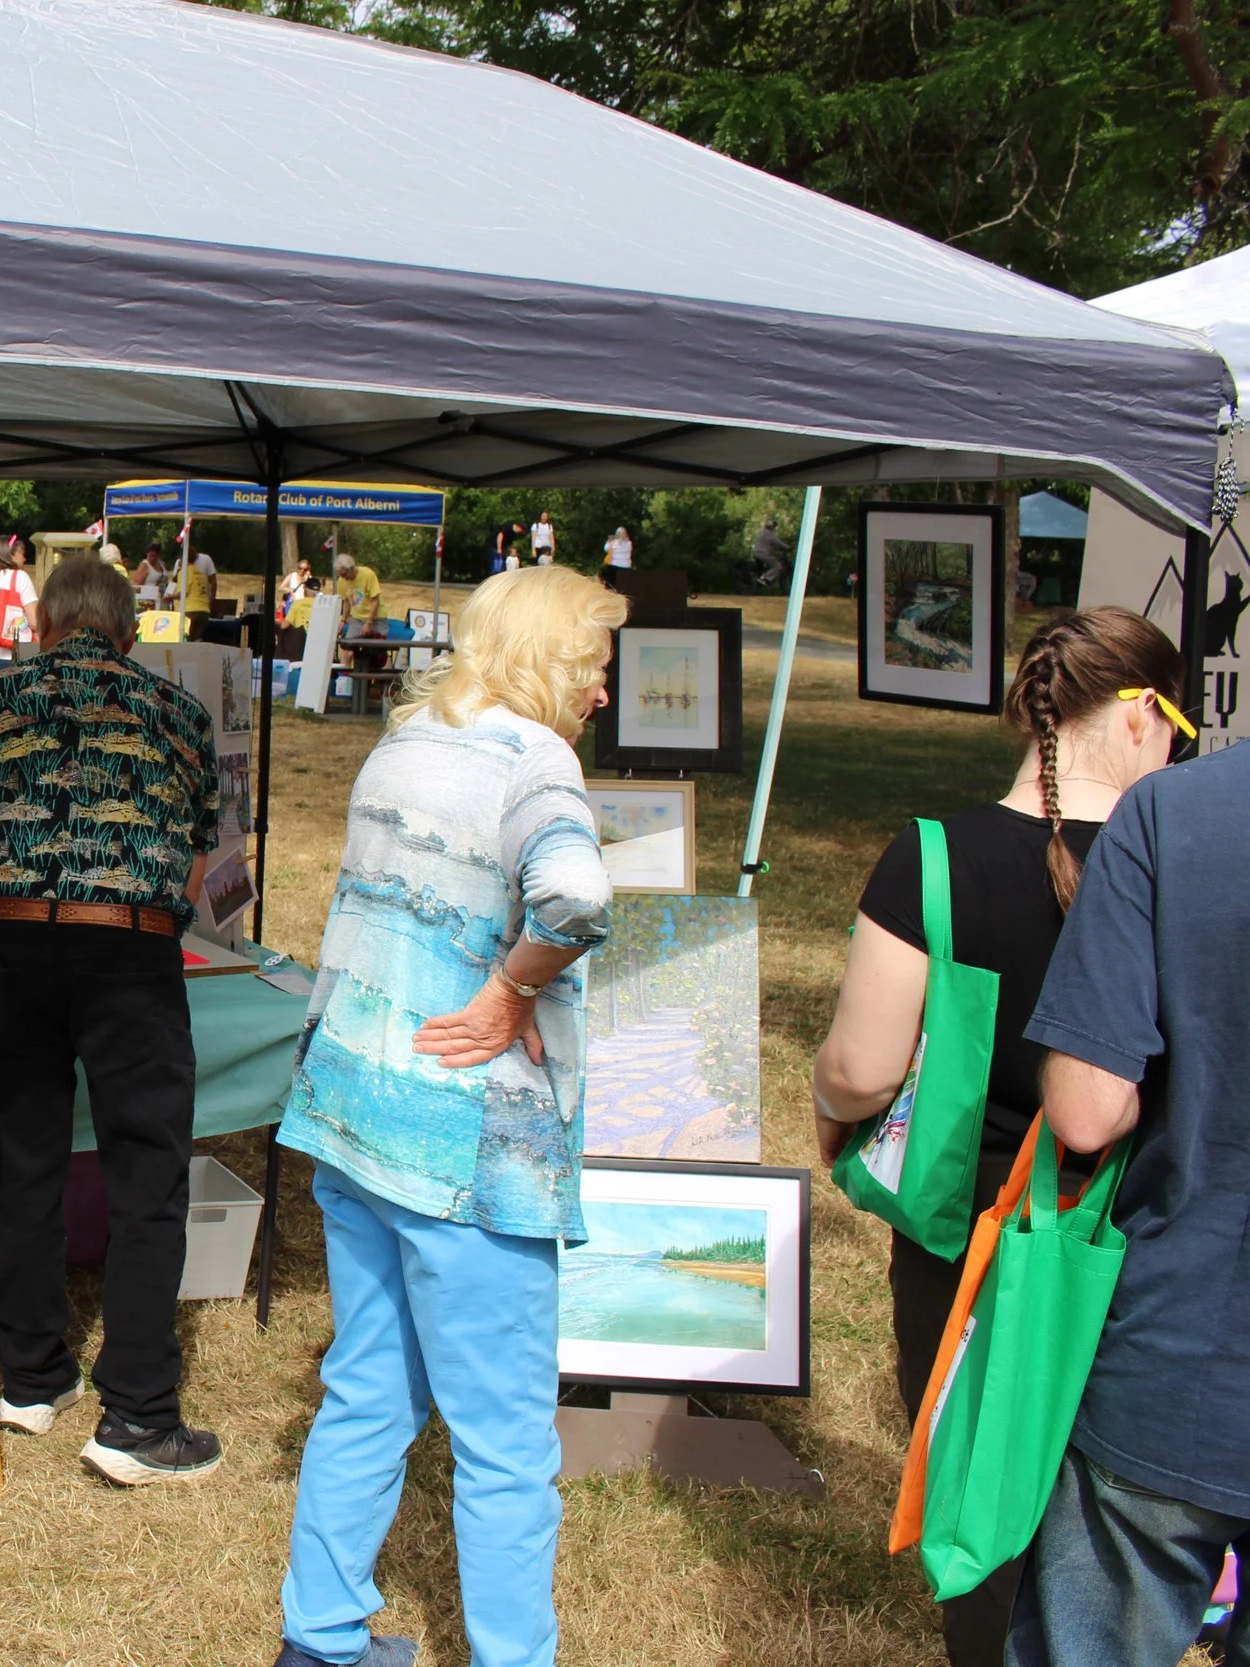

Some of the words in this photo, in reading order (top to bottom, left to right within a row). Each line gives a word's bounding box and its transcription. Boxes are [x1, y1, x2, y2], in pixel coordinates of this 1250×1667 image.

[233, 491, 268, 505] Rotar
[278, 493, 307, 507] Club
[309, 494, 324, 507] of
[326, 496, 353, 509] Port
[355, 498, 400, 511] Alberni
